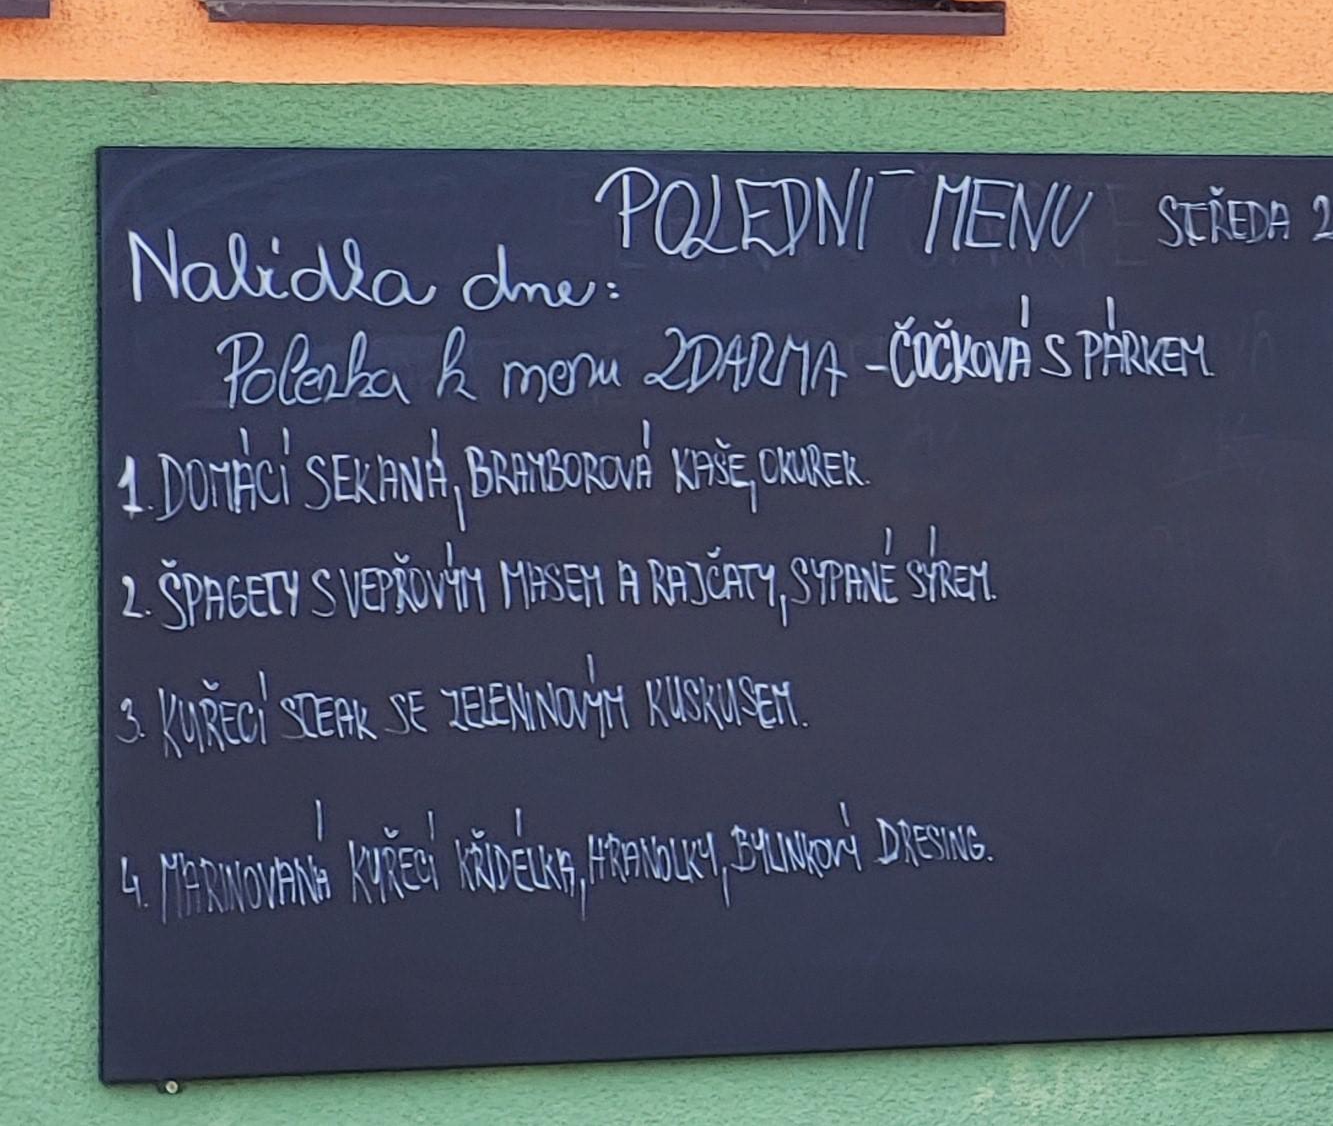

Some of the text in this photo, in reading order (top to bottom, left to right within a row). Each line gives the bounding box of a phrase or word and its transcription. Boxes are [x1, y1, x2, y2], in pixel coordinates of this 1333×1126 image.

[924, 174, 1094, 254] MENU
[1158, 185, 1290, 247] STŘEDA
[462, 244, 620, 311] dne:
[436, 326, 477, 401] k
[503, 352, 621, 403] menu
[643, 327, 848, 398] ZDARMA
[1040, 333, 1072, 377] S
[117, 454, 154, 520] 1.
[156, 427, 290, 521] DOMÁCÍ
[463, 419, 653, 498] BRAMBOROVÁ
[121, 575, 151, 619] 2.
[158, 558, 299, 630] ŠPAGETY
[311, 568, 336, 617] S
[339, 541, 486, 619] VEPŘOVÝM
[499, 560, 605, 610] MASEM
[617, 559, 640, 605] A
[790, 527, 899, 605] SYPANÉ
[906, 525, 997, 603] SÝREM.
[114, 653, 810, 759] 3. KUŘECÍ STEAK SE ZELENINOVÝM KUSKUSEM.
[120, 855, 149, 908] 4.
[160, 798, 332, 924] MARINOVANÁ
[348, 810, 439, 904] KUŘECÍ
[730, 801, 862, 878] BYLINKOVÝ
[873, 817, 994, 867] DRESING.
